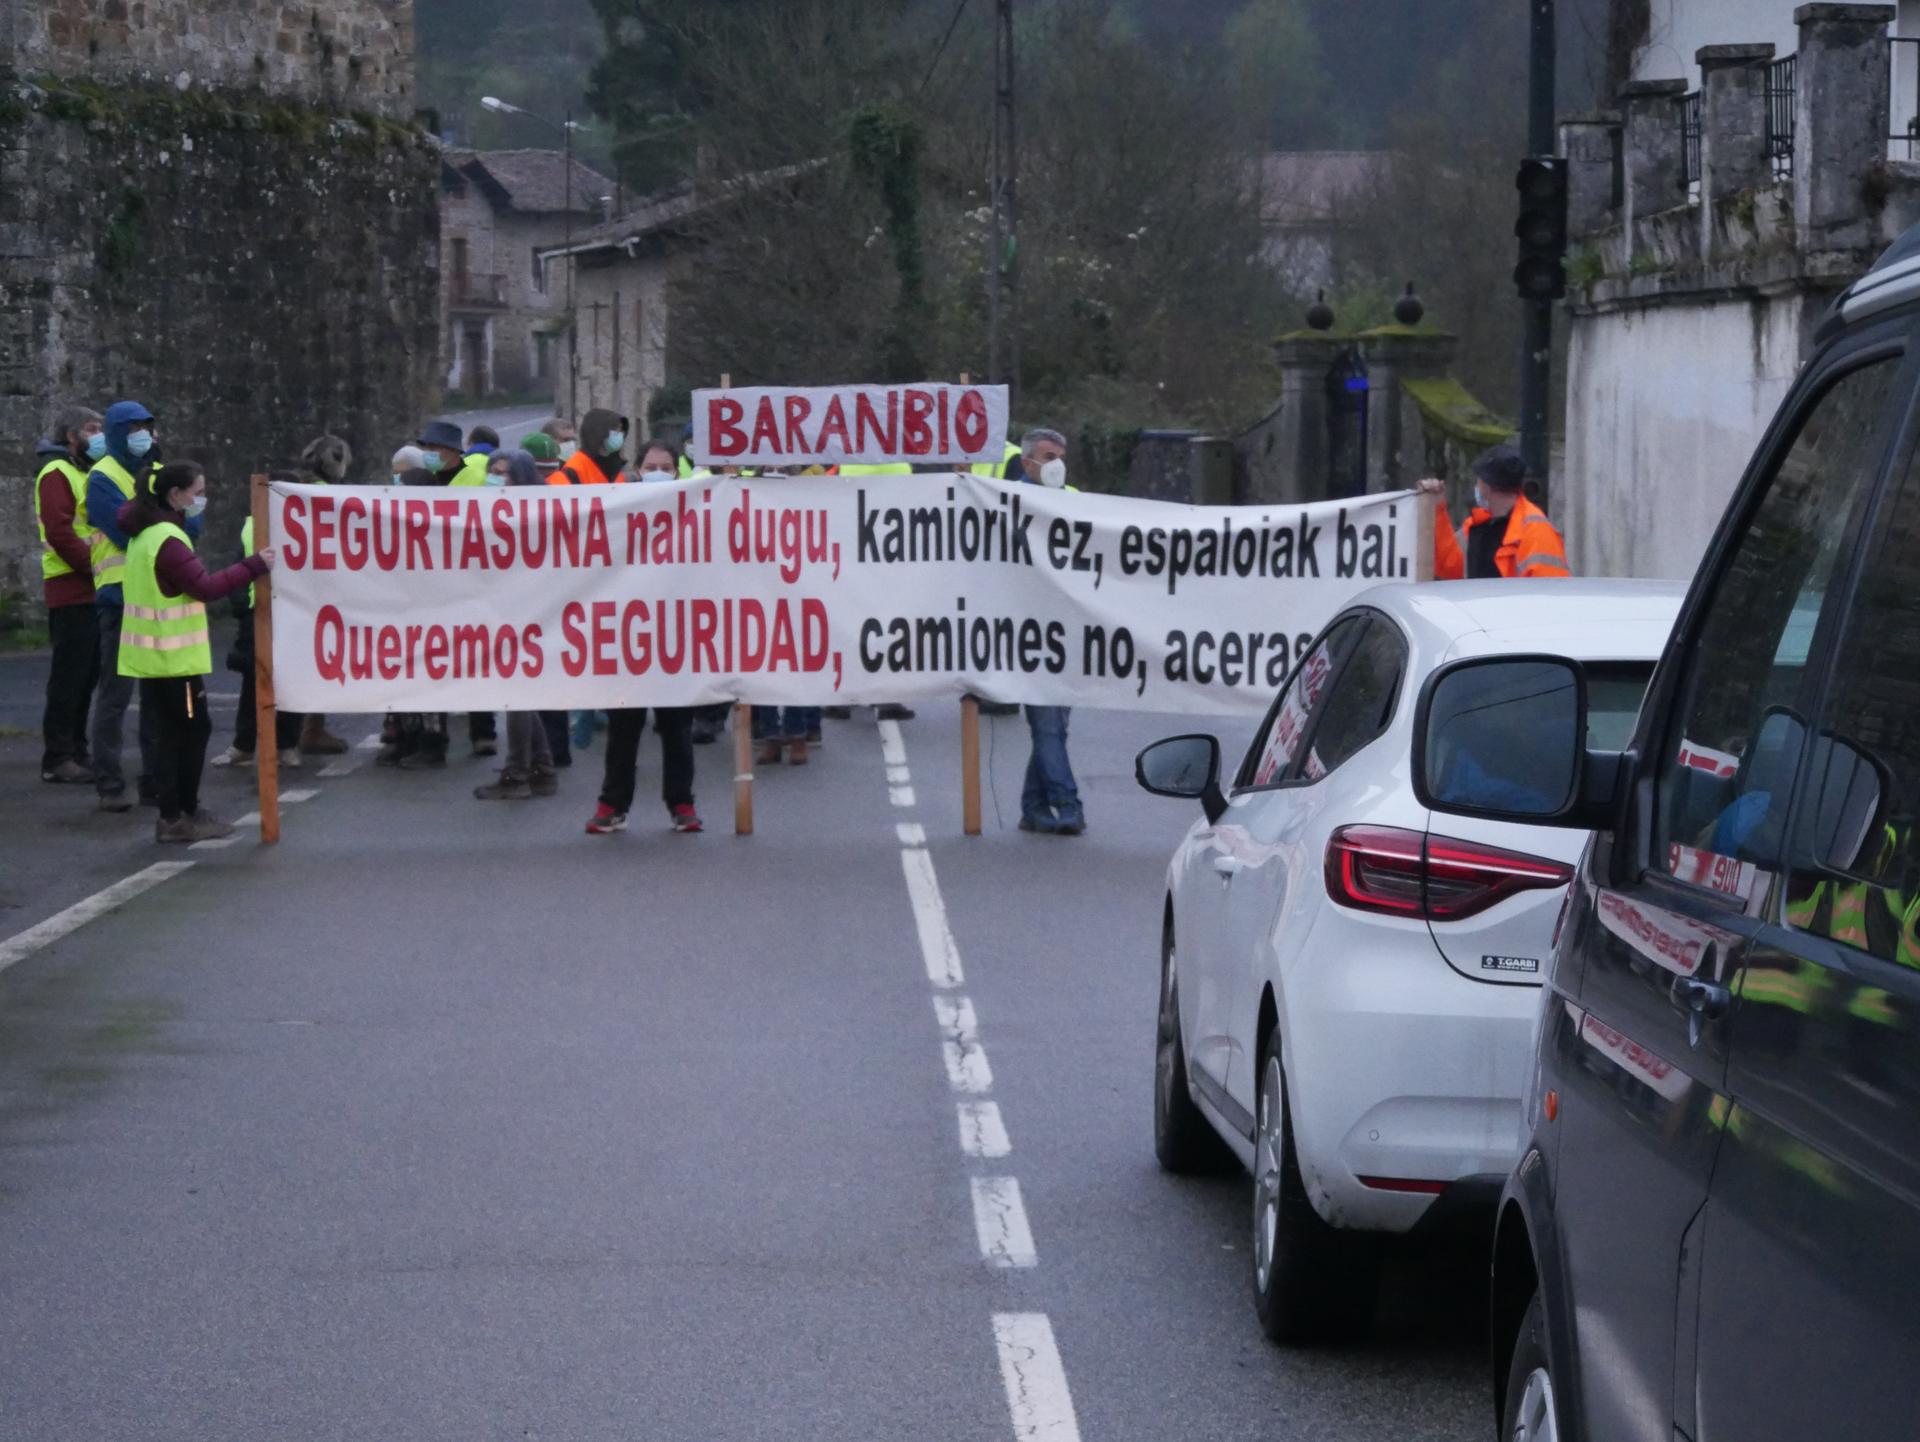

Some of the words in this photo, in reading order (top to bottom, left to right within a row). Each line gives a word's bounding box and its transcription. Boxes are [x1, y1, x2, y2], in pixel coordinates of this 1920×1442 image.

[709, 390, 987, 456] BARANBIO
[282, 495, 612, 572] SEGURTASUNA
[626, 490, 712, 565] nahi
[728, 488, 841, 584] dugu,
[857, 487, 1034, 565] kamiorik
[1048, 517, 1103, 590] ez,
[1120, 511, 1321, 594] espaloiak
[1336, 504, 1408, 578] bai.
[314, 604, 545, 687] Queremos
[561, 598, 842, 691] SEGURIDAD,
[859, 597, 1066, 674] camiones
[1083, 625, 1147, 696] no,
